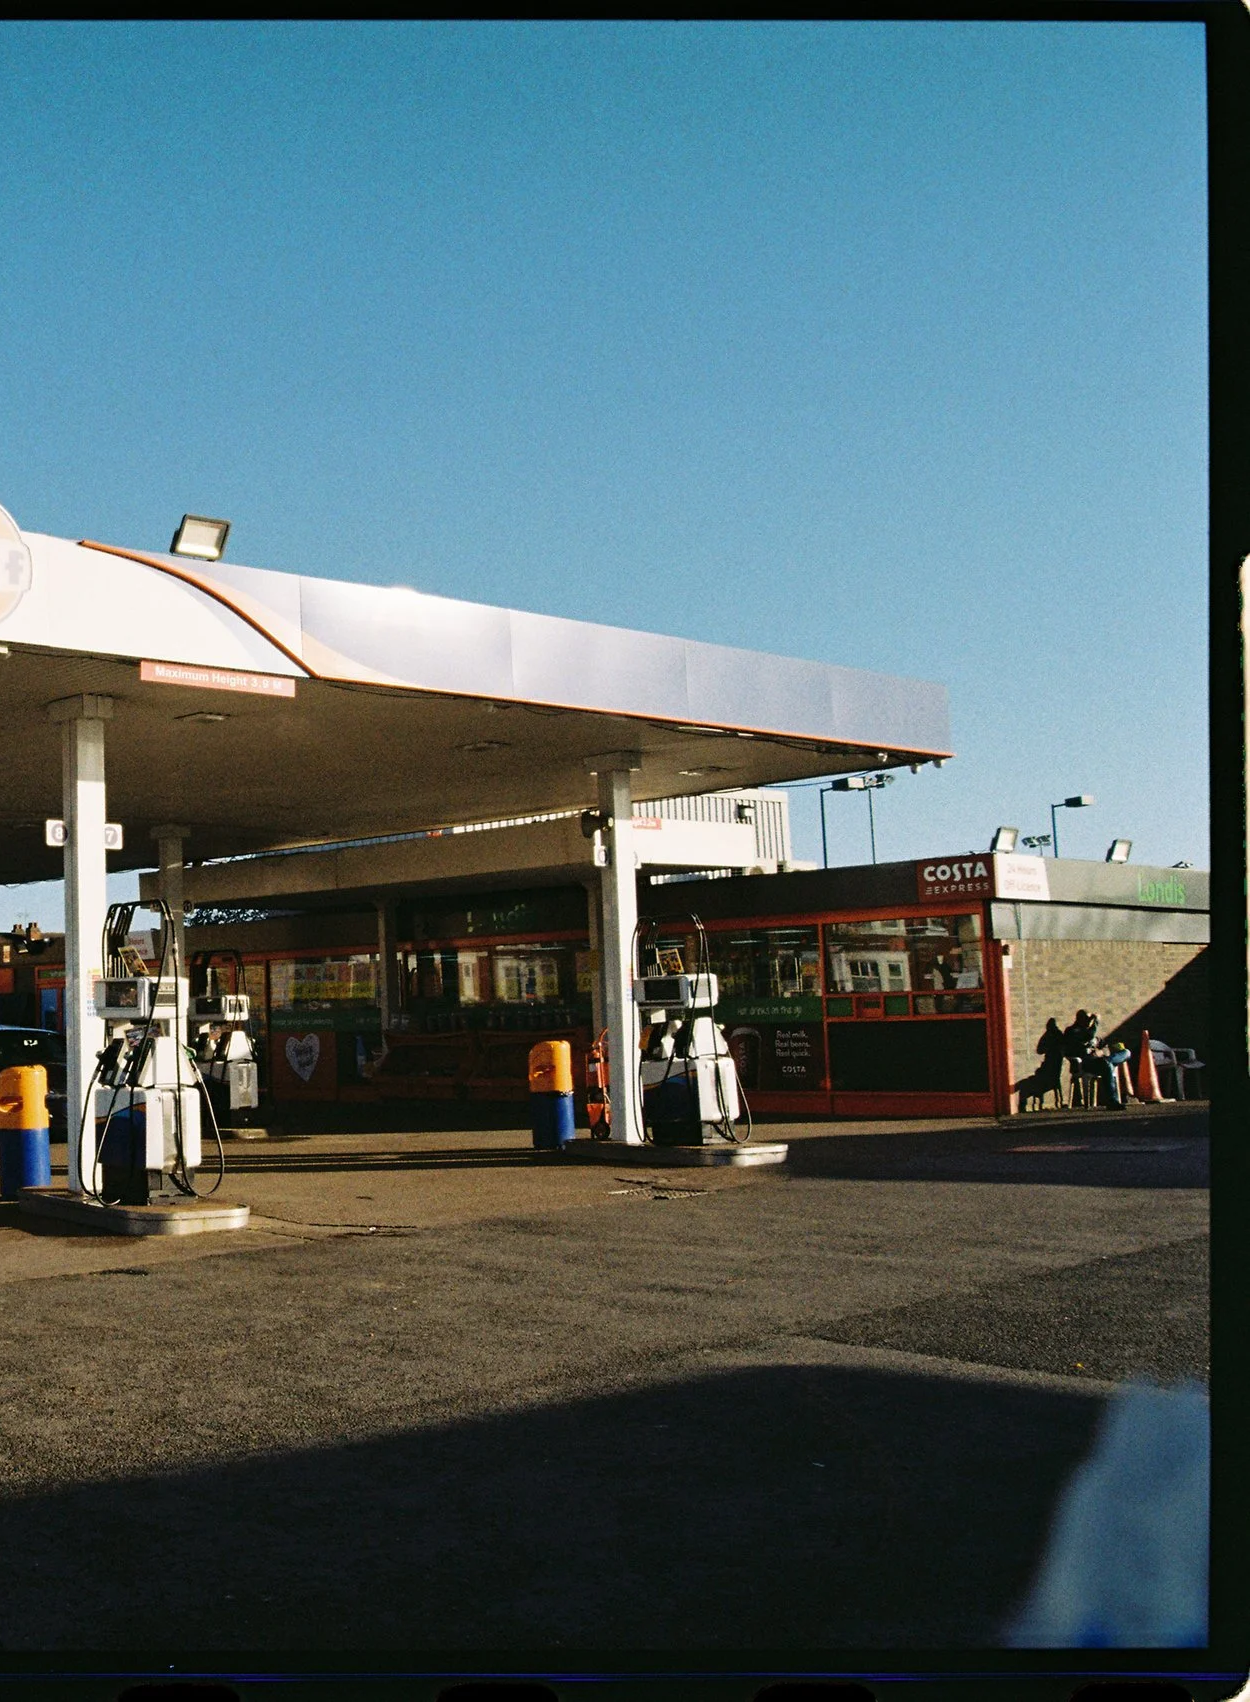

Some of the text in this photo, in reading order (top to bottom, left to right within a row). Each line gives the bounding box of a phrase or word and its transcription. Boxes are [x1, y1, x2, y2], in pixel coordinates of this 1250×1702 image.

[154, 665, 209, 682] Maximum
[211, 672, 247, 688] Height
[55, 827, 63, 840] 8
[105, 830, 114, 842] 7
[923, 861, 989, 882] COSTA
[934, 882, 990, 894] EXPRESS
[1138, 873, 1186, 904] Londis
[781, 1065, 806, 1074] COSTA
